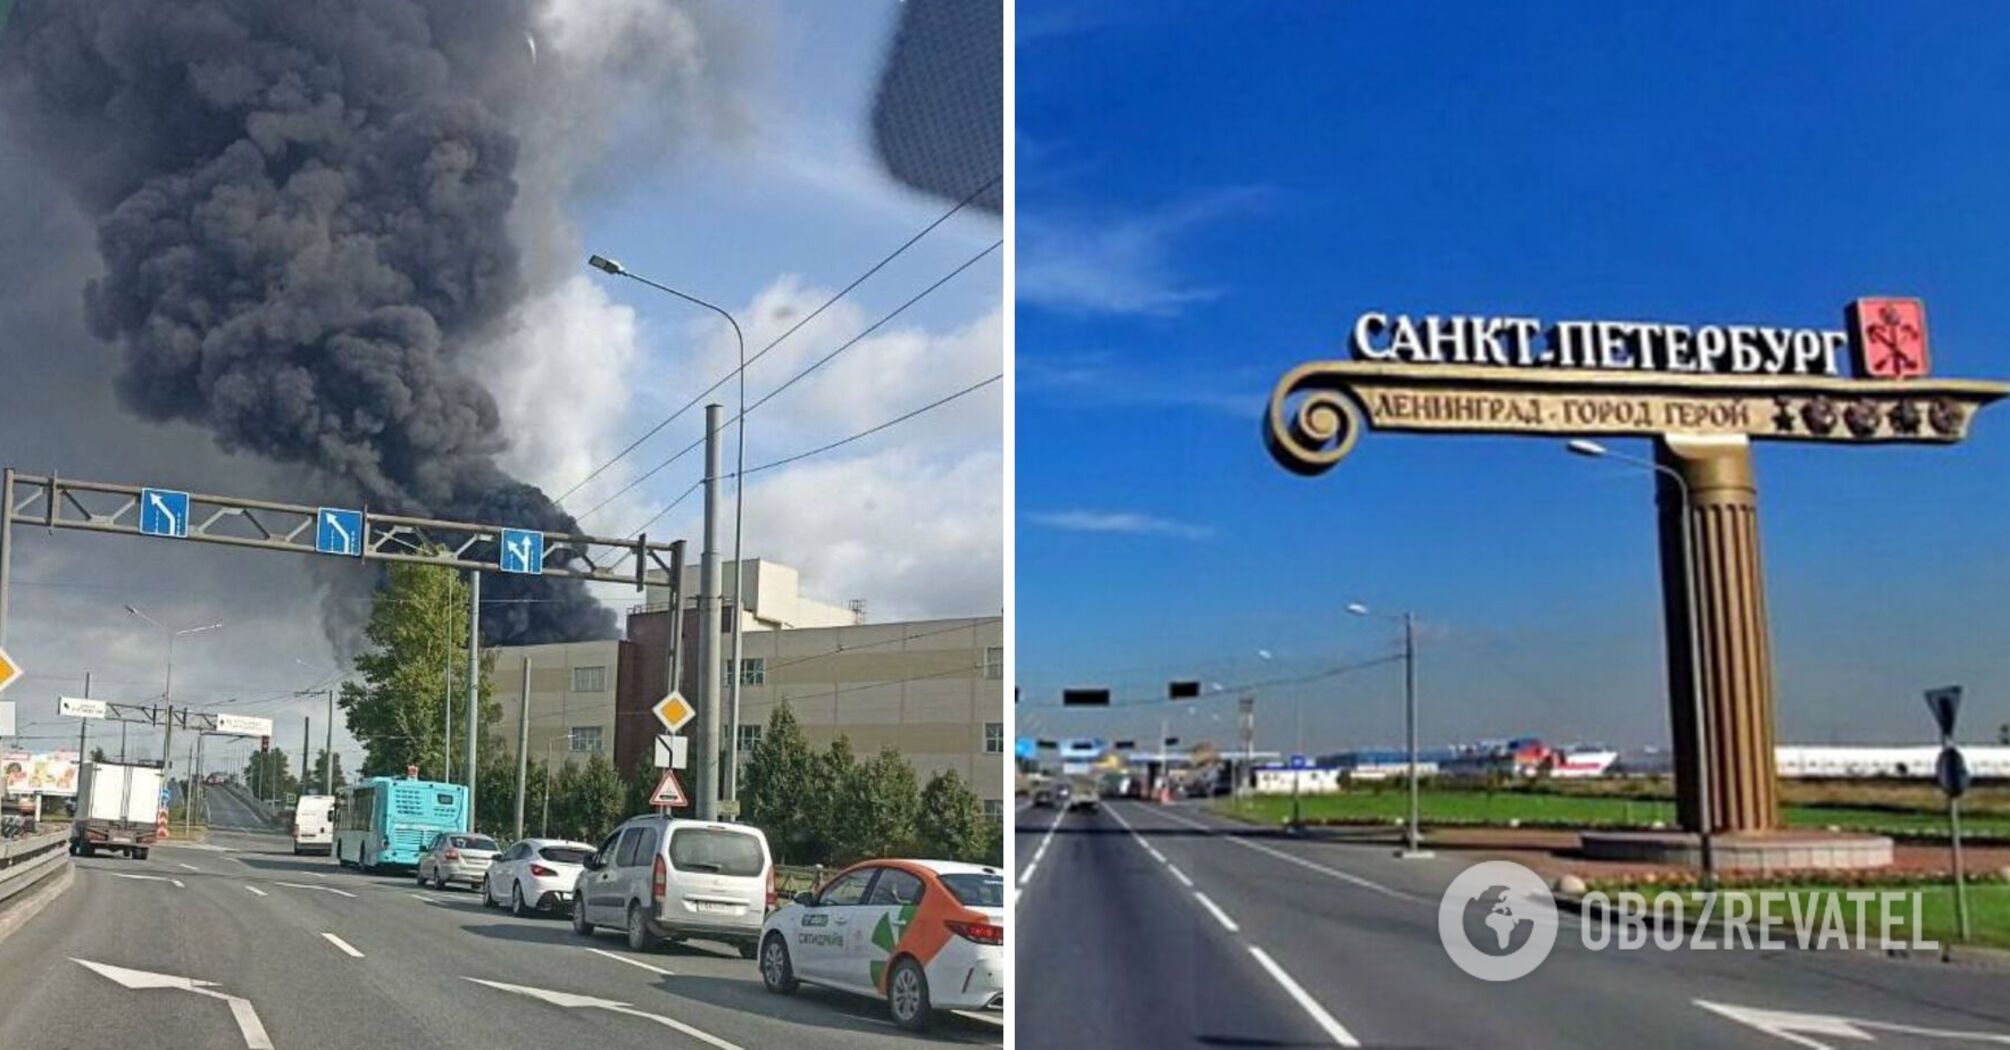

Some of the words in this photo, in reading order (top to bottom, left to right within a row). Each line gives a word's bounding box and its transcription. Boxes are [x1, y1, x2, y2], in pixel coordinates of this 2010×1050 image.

[1355, 311, 1848, 375] САНКТ-ПЕТЕРБУРГ
[1374, 394, 1542, 424] ЛЕНИНГРАД
[1562, 399, 1653, 426] ГОРОД
[1664, 398, 1749, 427] ГЕРОЙ
